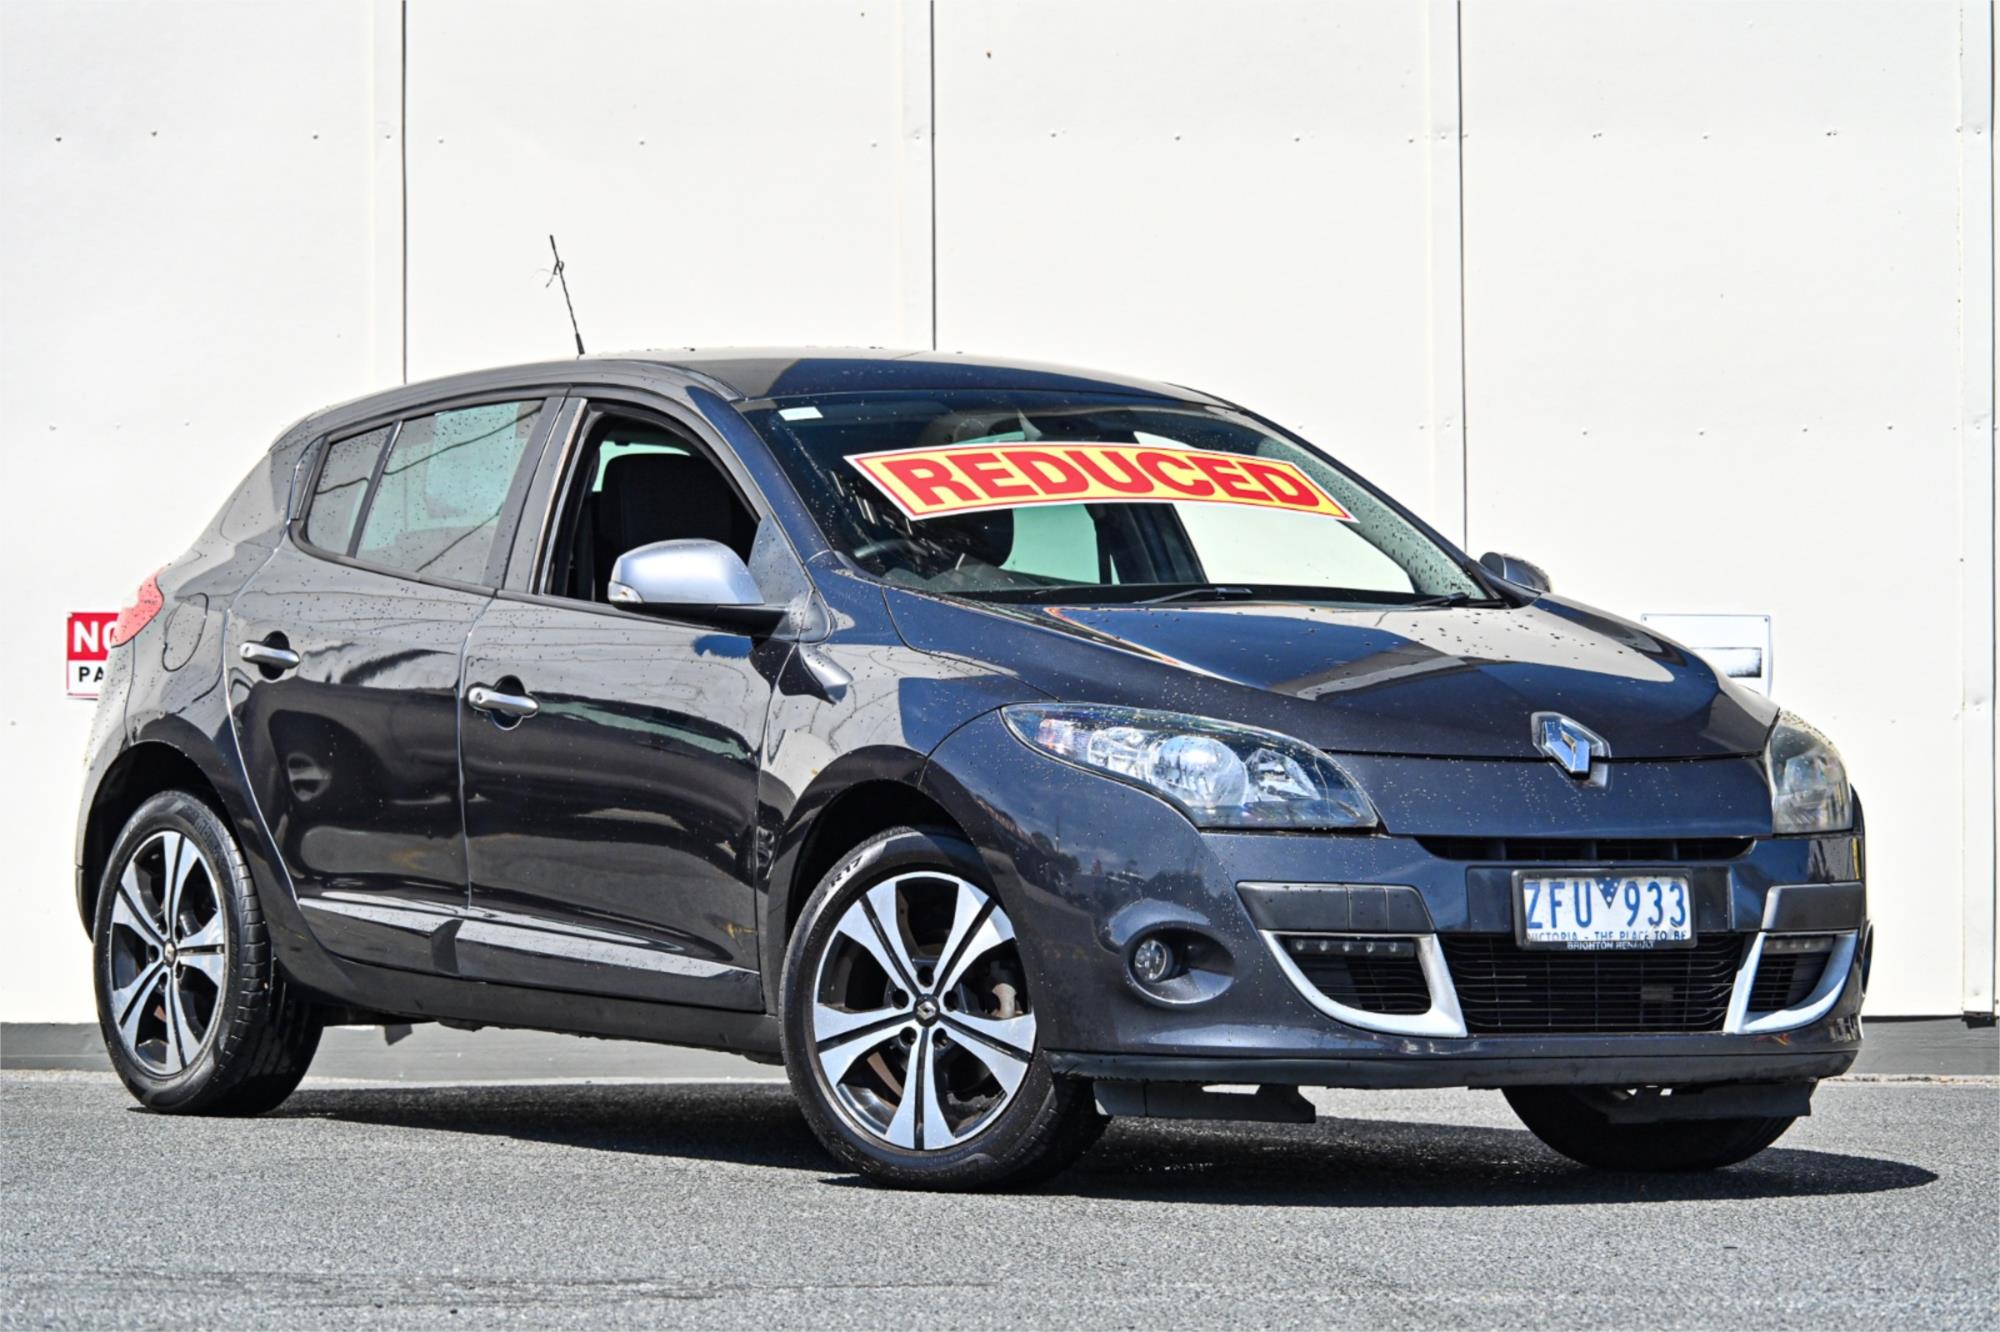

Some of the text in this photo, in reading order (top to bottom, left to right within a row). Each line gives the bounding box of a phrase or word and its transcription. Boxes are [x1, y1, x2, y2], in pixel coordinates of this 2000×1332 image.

[880, 450, 1321, 507] REDUCED
[1524, 881, 1687, 930] ZFU 933
[1594, 931, 1614, 941] THE
[1655, 930, 1668, 941] TO
